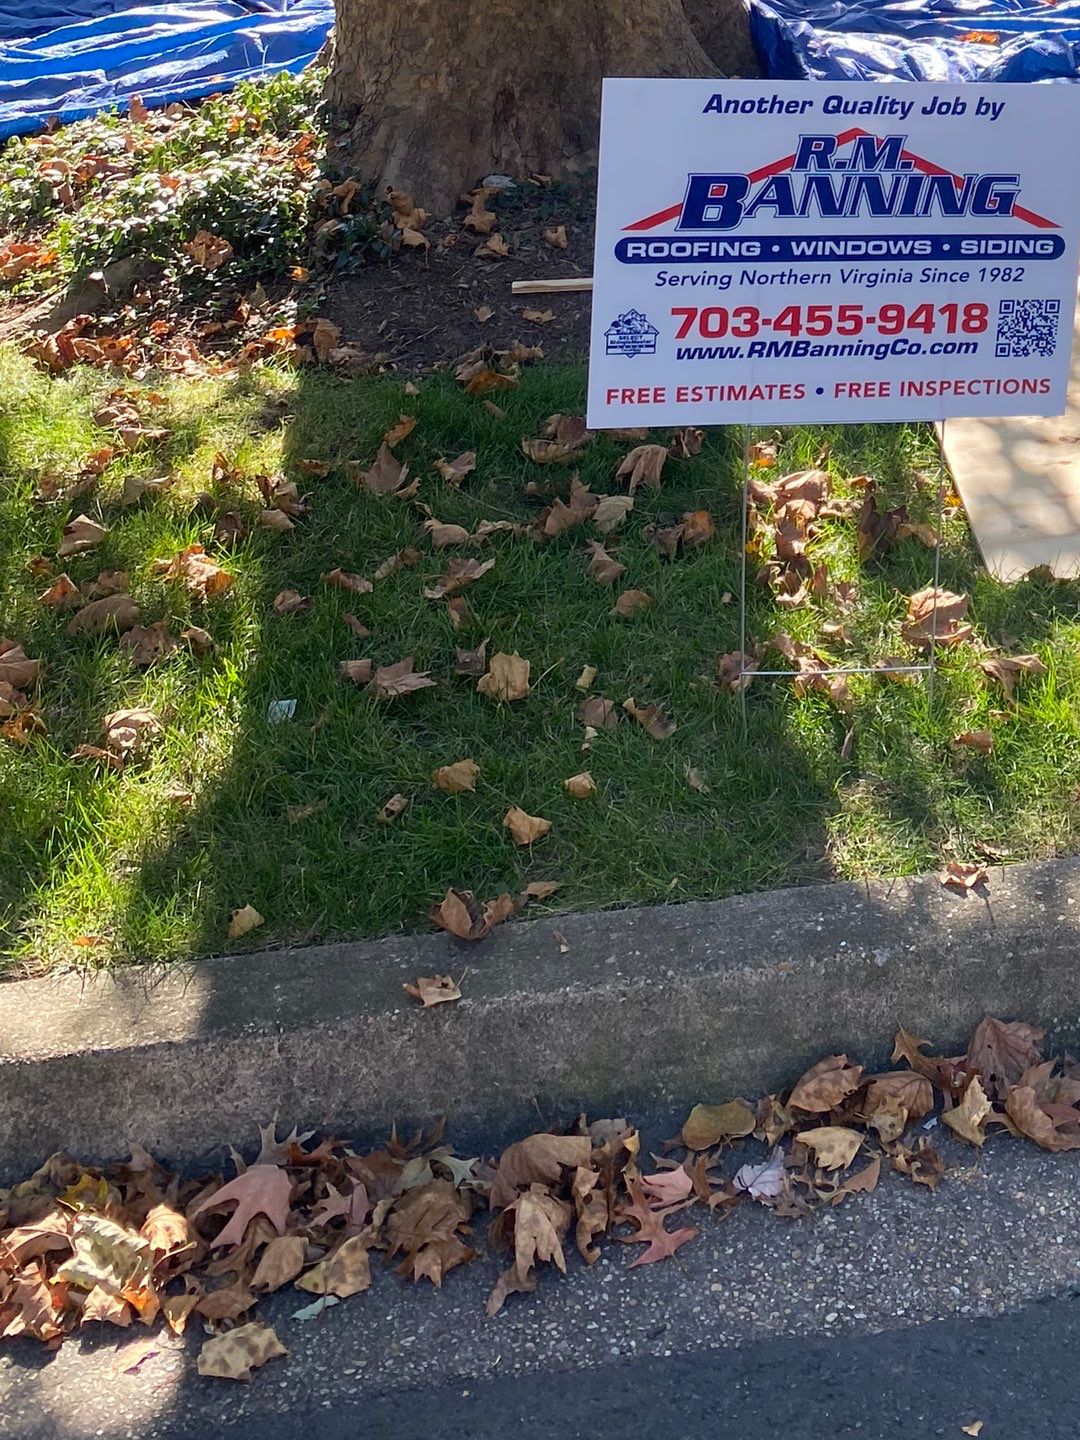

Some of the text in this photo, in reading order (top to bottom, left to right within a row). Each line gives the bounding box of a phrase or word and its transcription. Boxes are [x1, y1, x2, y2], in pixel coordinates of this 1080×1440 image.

[703, 94, 1006, 121] Another Quality Job by
[790, 133, 914, 173] R.M.
[674, 173, 1021, 232] BANNING
[626, 239, 1055, 258] ROOFING WINDOWS SIDING
[655, 267, 1025, 290] Serving Northern Virginia Since 1982
[670, 303, 989, 339] 703-455-9418
[676, 338, 978, 360] www.RMBanningCo.com
[606, 378, 1051, 405] FREE ESTIMATES FREE INSPECTIONS
